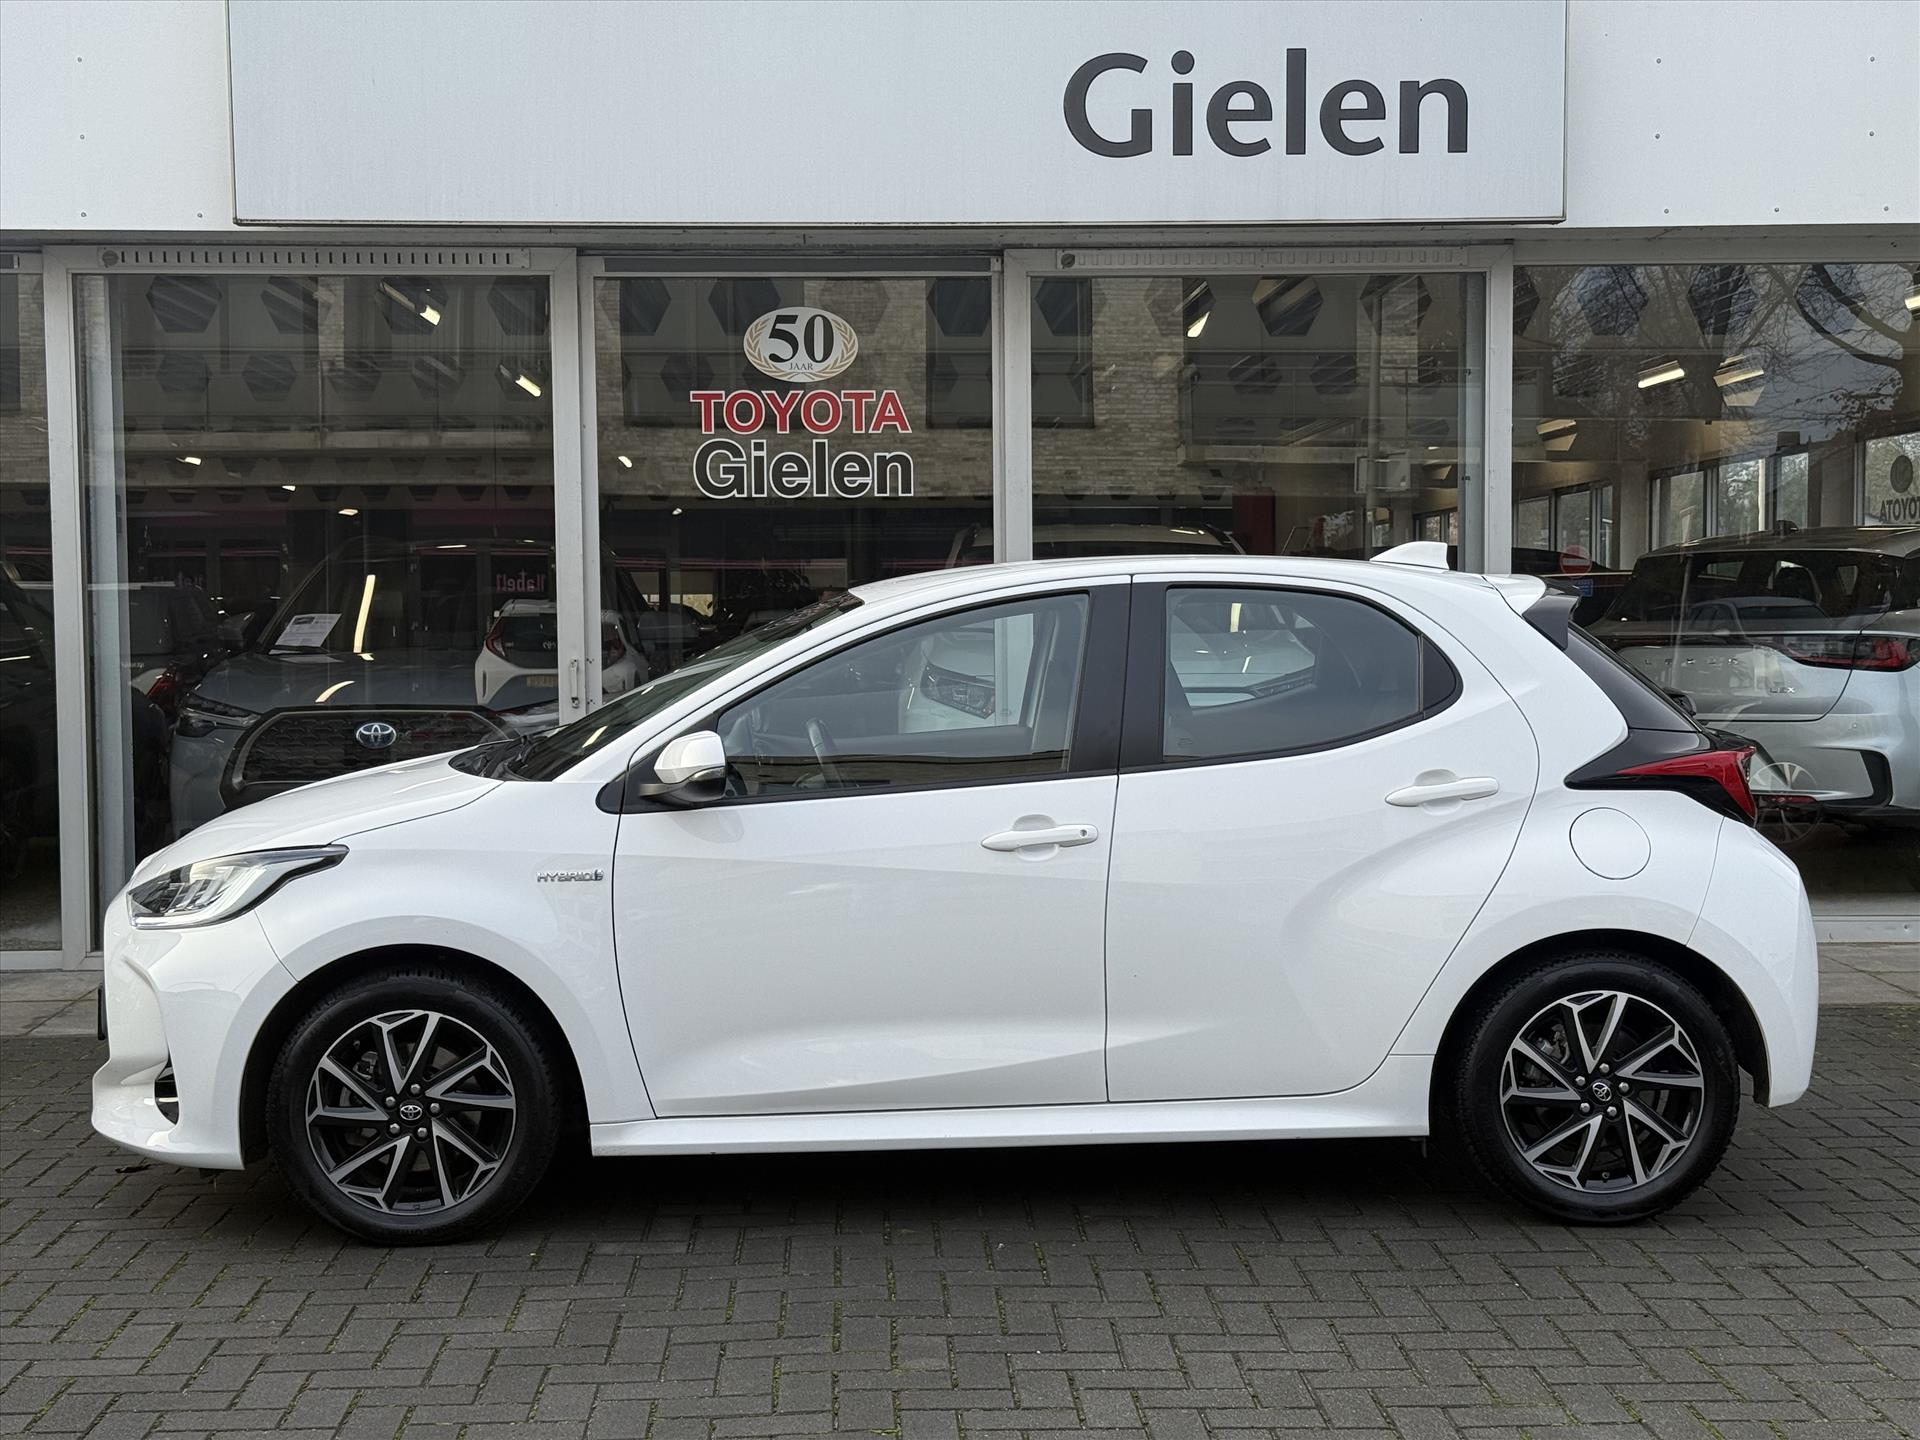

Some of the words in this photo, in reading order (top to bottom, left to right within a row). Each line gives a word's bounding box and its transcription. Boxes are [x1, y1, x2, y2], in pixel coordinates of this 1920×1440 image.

[1063, 48, 1468, 158] Gielen
[768, 314, 834, 363] 50
[789, 362, 814, 371] JAAR
[690, 390, 912, 435] TOYOTA
[693, 438, 914, 499] Gielen
[536, 871, 593, 882] HYBRID
